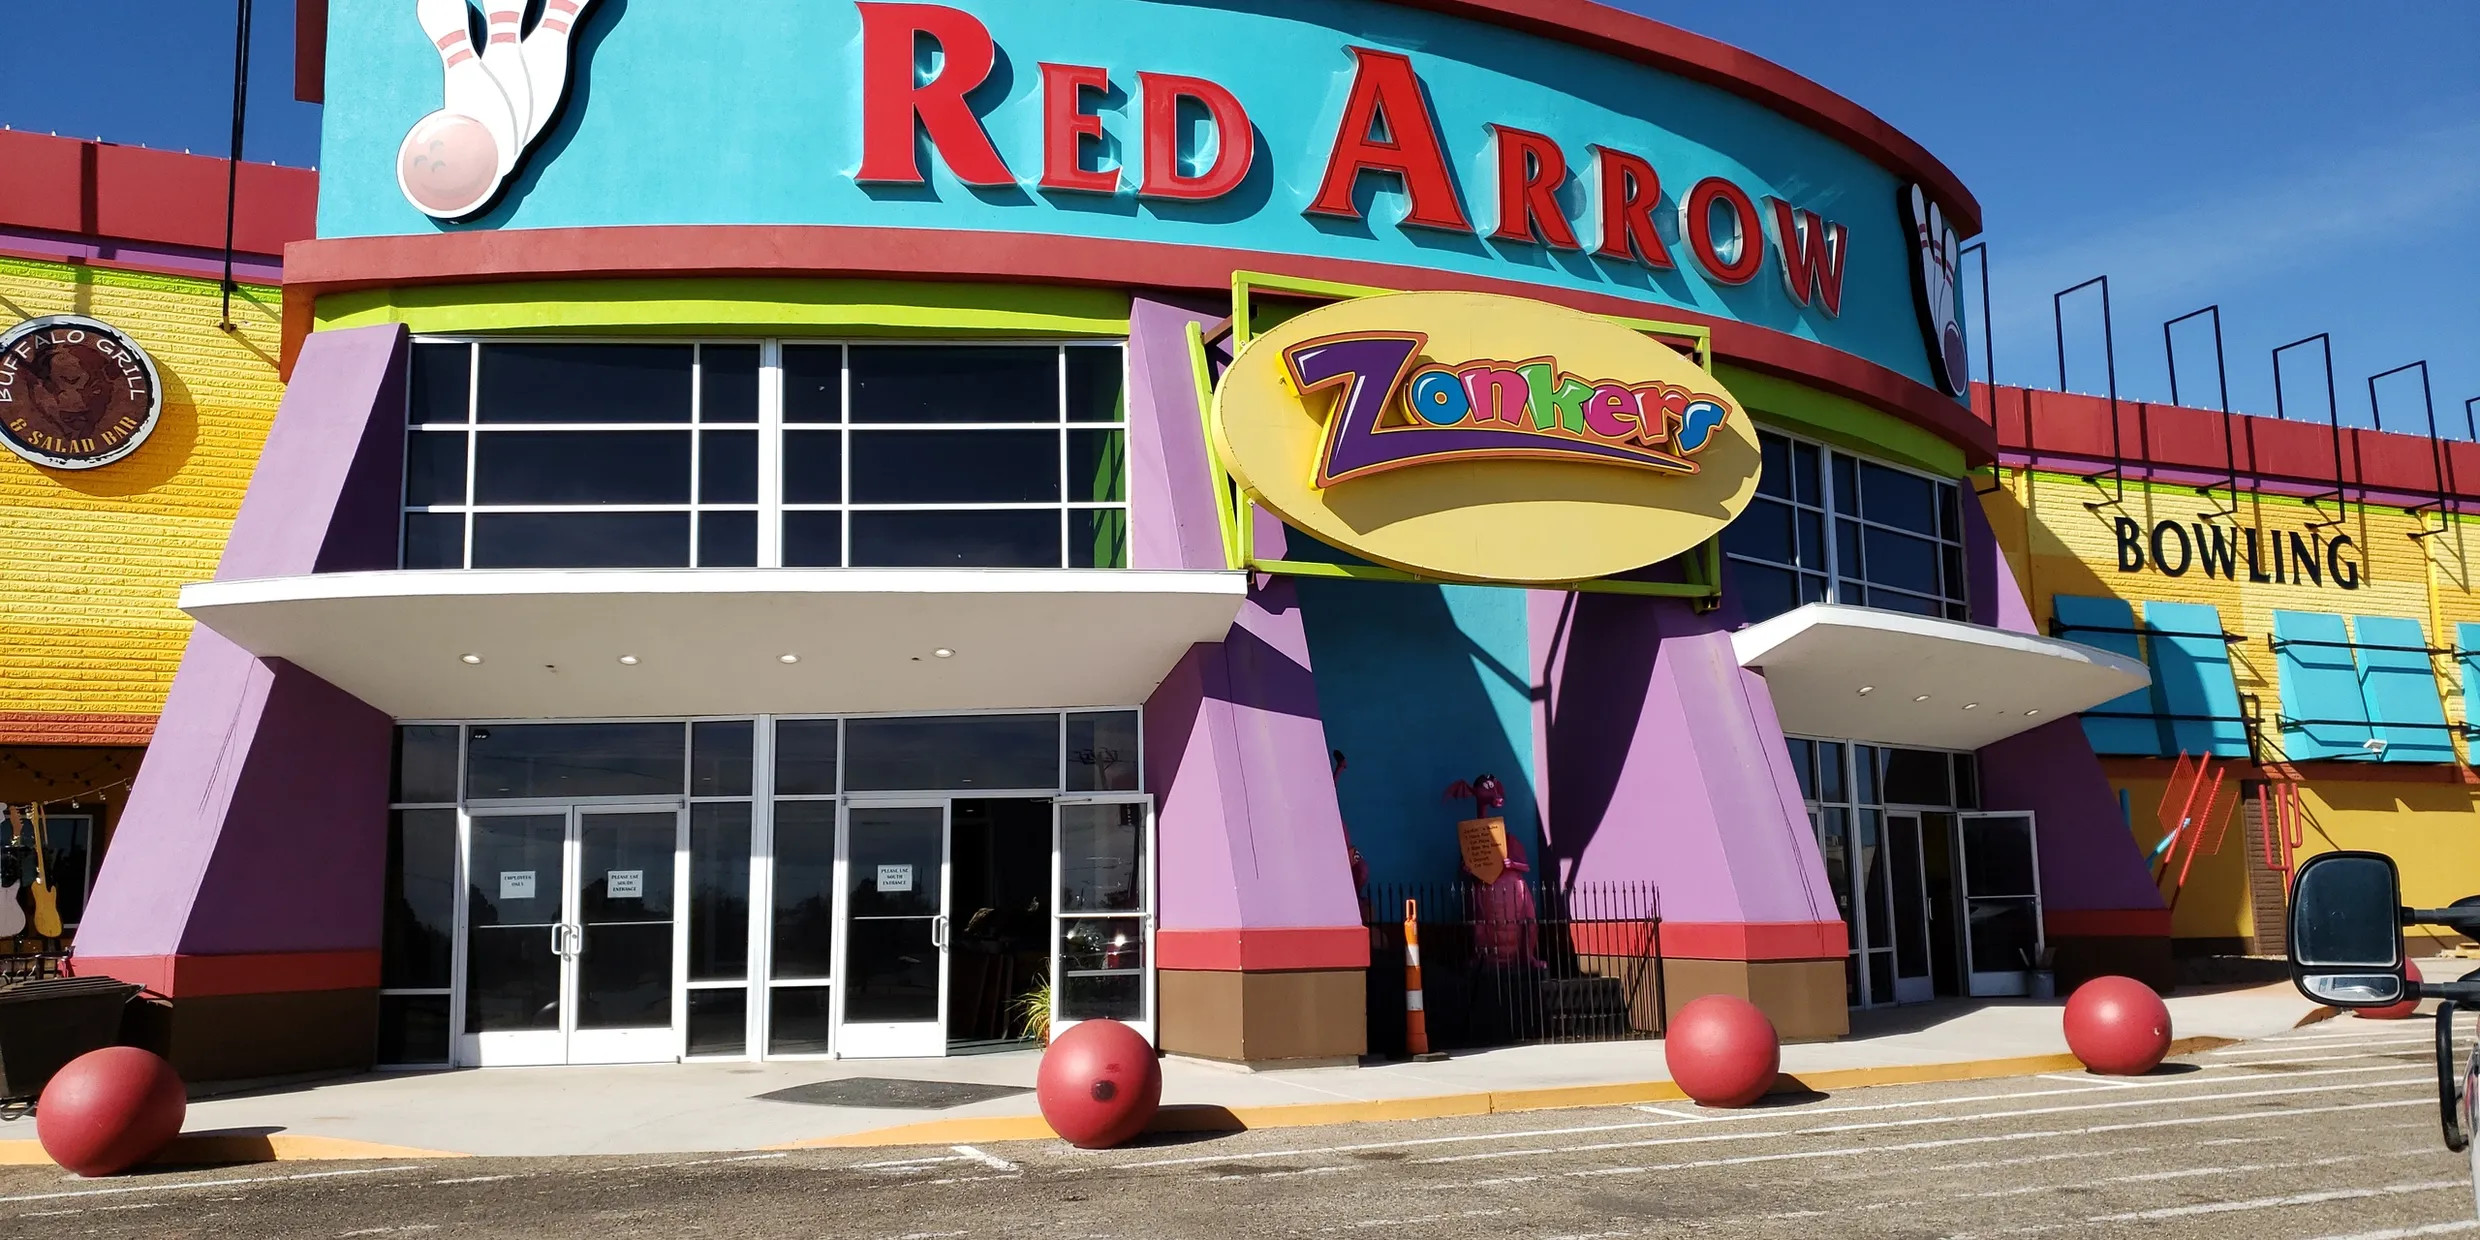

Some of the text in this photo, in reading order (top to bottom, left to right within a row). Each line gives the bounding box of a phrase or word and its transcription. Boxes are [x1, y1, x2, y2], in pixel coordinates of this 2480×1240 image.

[854, 1, 1850, 319] RED ARROW
[0, 329, 146, 402] BUFFALO GRILL
[28, 430, 96, 453] SALAD
[101, 415, 138, 446] BAR
[1276, 329, 1733, 489] Zonkers
[2114, 516, 2360, 590] BOWLING
